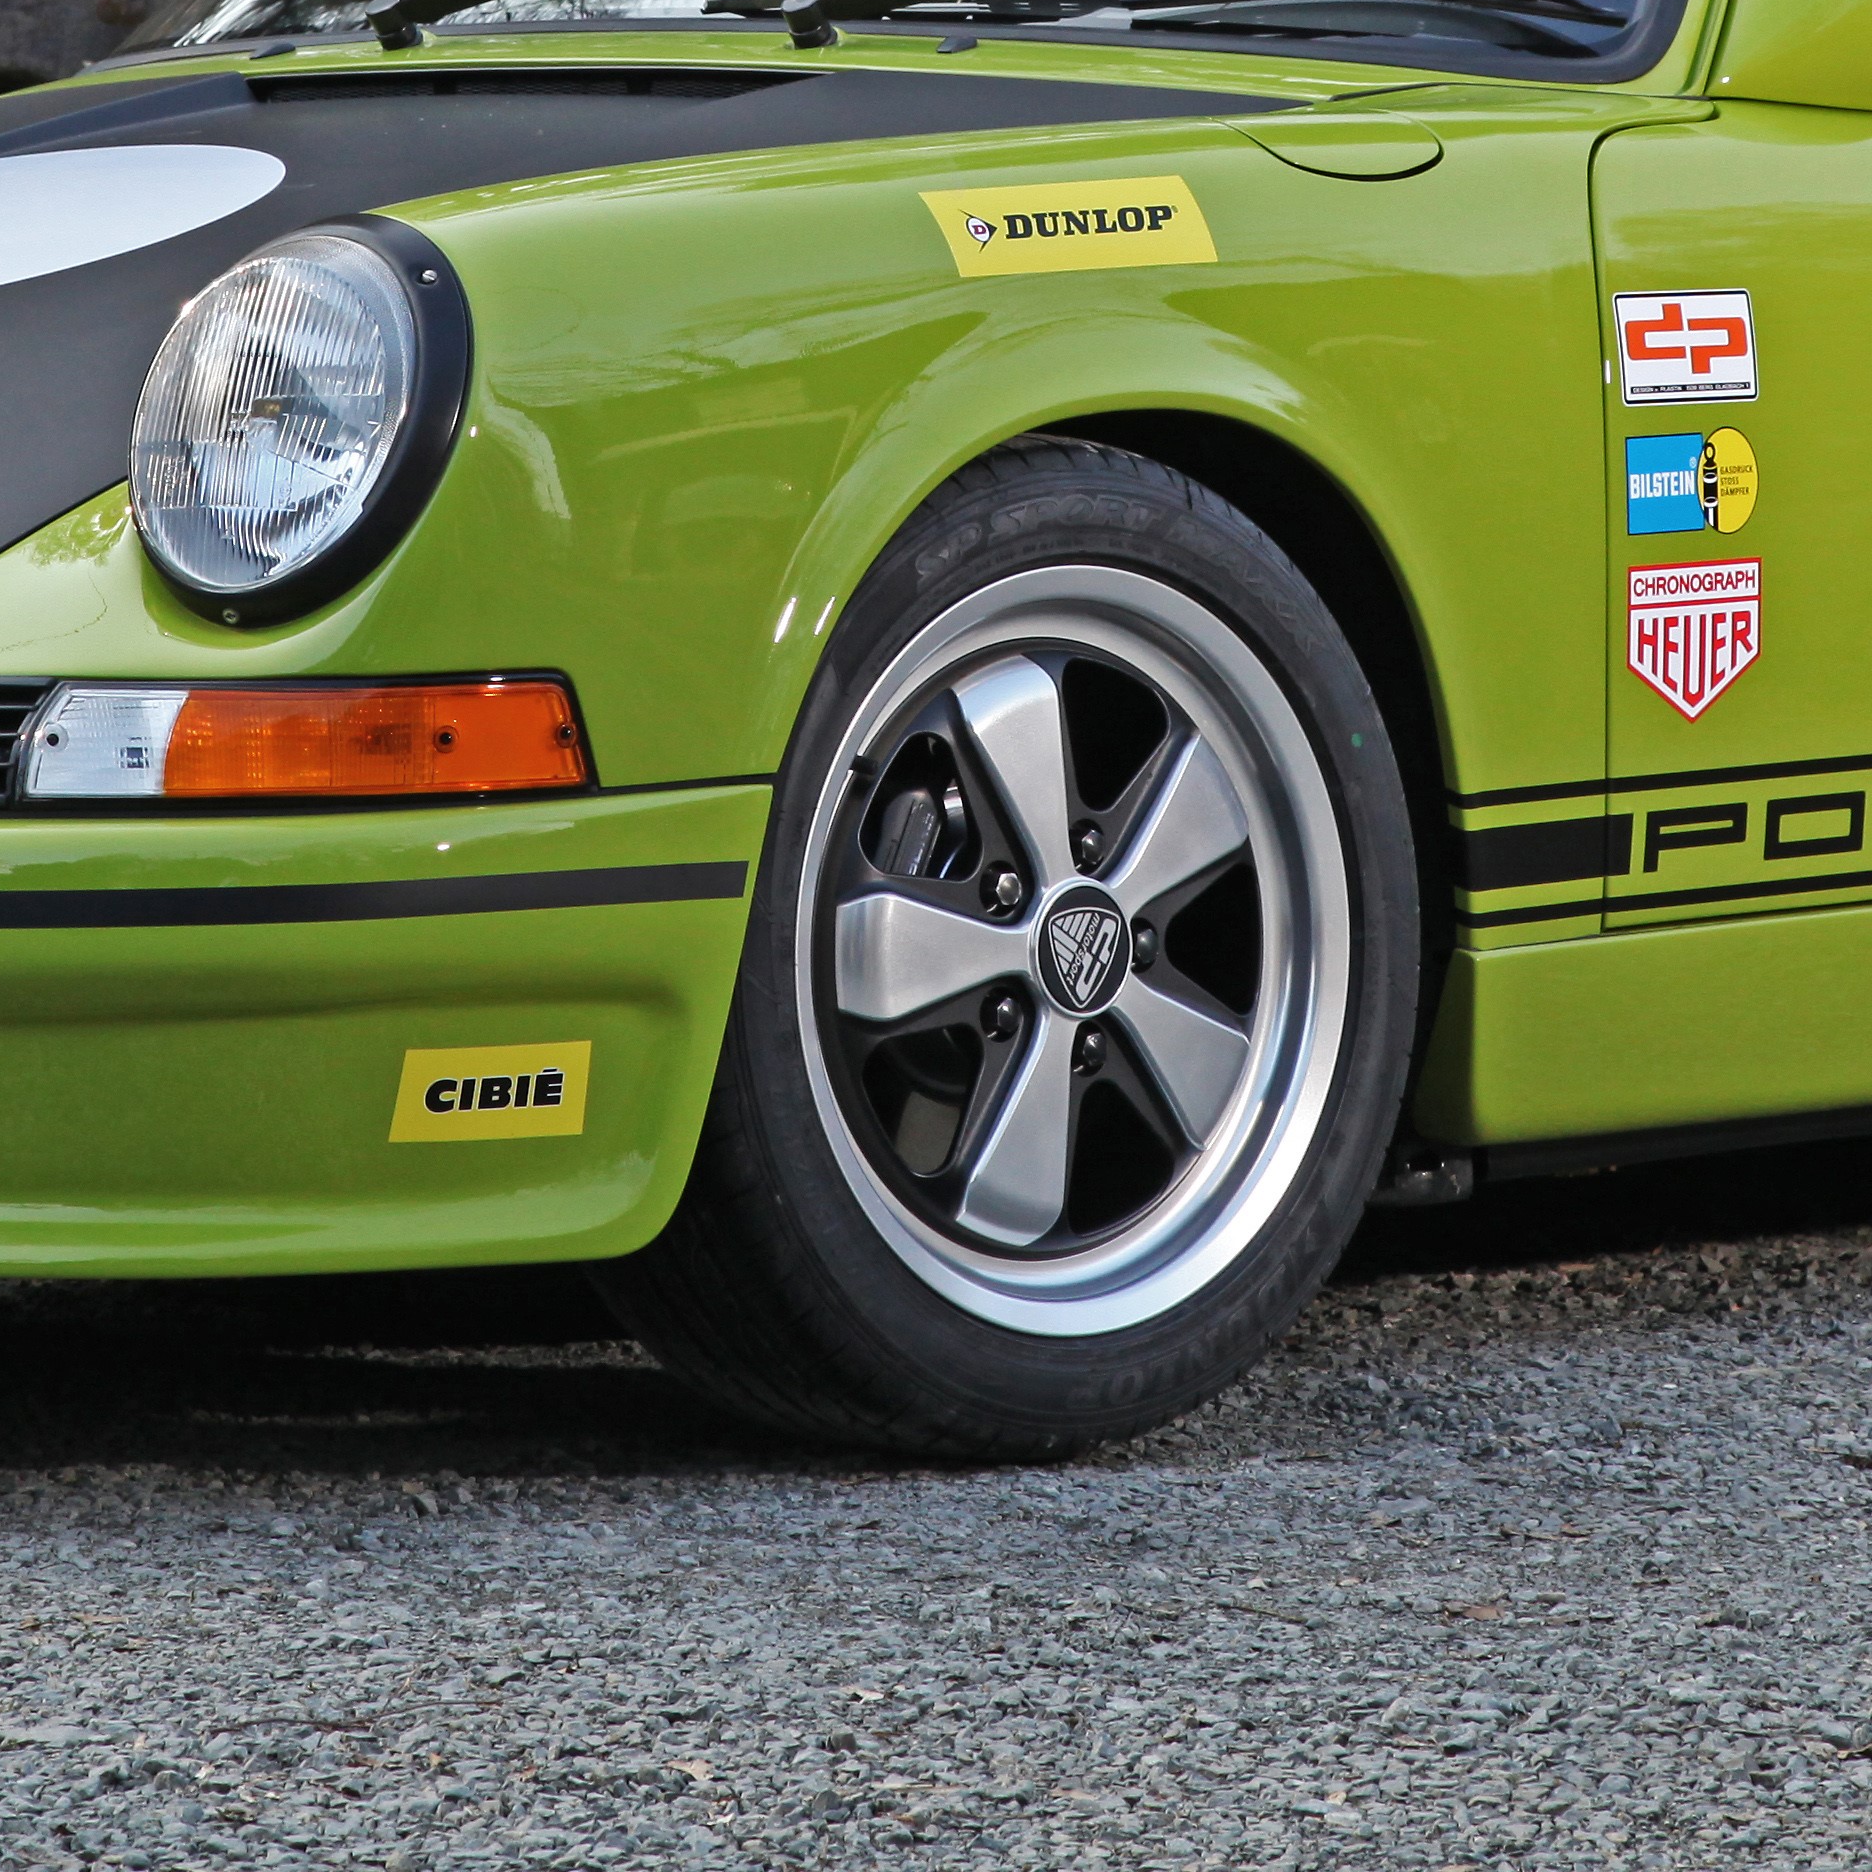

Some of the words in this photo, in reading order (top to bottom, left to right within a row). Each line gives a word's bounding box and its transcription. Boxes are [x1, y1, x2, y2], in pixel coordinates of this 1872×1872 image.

[1002, 204, 1174, 240] DUNLOP
[1624, 302, 1749, 375] dp
[1629, 470, 1696, 499] BILSTEIN
[988, 493, 1164, 546] SPORT
[1633, 568, 1756, 597] CHRONOGRAPH
[1637, 610, 1754, 708] HEUER
[1065, 912, 1101, 986] motorsport
